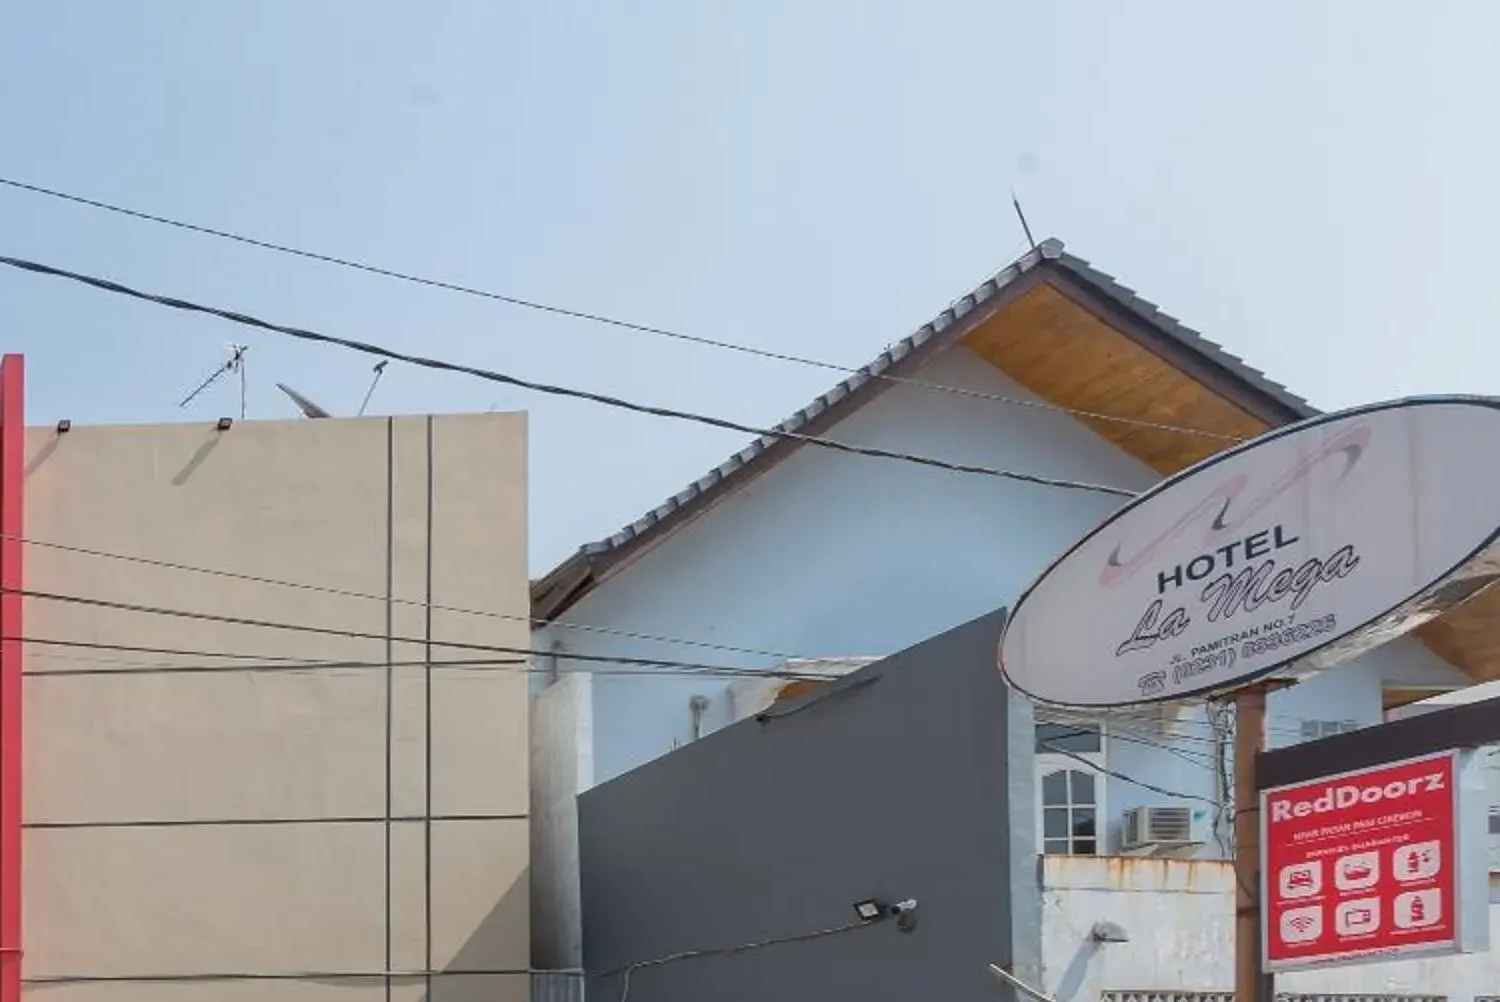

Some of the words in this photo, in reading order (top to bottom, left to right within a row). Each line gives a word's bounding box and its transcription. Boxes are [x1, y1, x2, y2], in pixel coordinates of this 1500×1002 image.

[1157, 525, 1300, 594] HOTEL
[1115, 598, 1190, 657] La
[1200, 543, 1360, 623] Mega
[1272, 771, 1445, 823] RedDoorz
